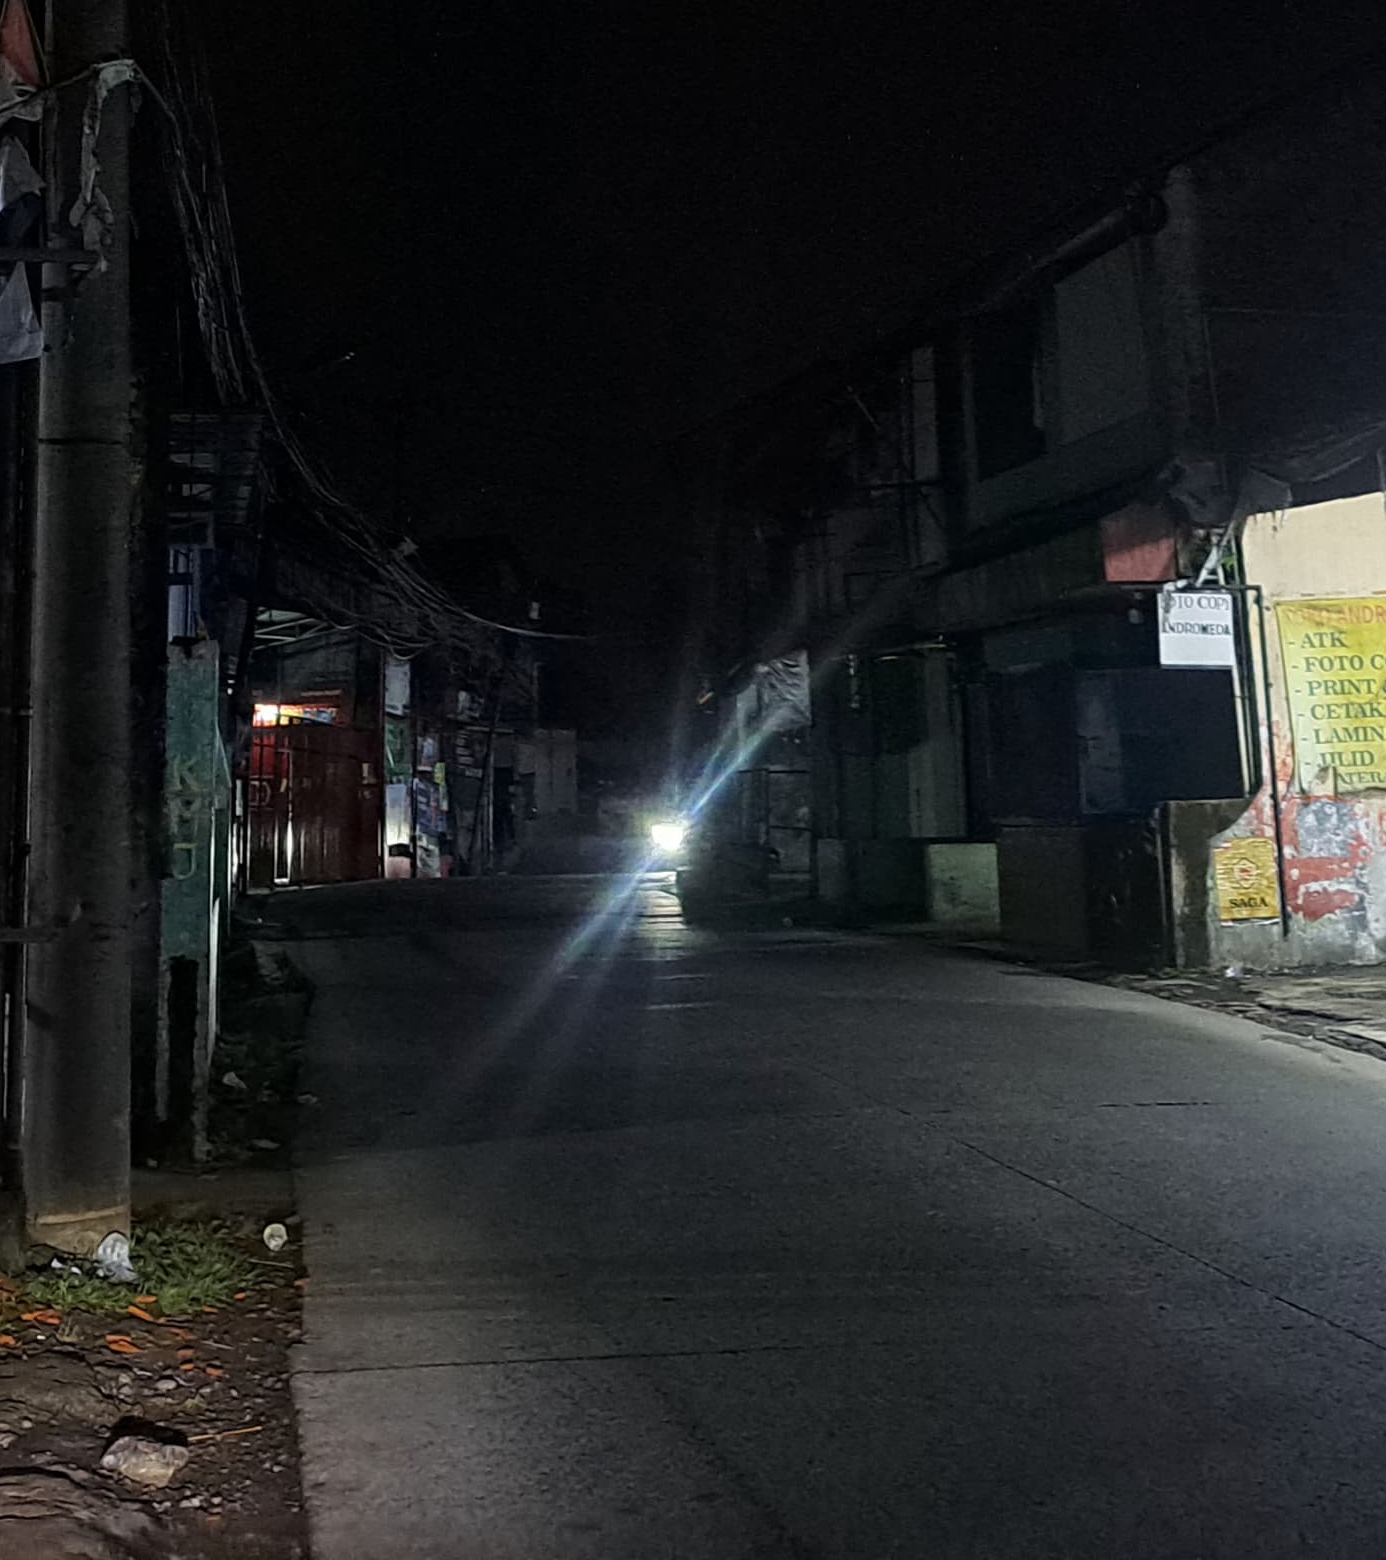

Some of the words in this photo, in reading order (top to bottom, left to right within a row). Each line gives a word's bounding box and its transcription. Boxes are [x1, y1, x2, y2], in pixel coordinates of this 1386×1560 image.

[1300, 631, 1348, 649] ATK
[1304, 654, 1364, 673] FOTO
[1307, 677, 1377, 696] PRINT
[1310, 702, 1386, 721] CETAK
[1228, 897, 1269, 909] SAGA
